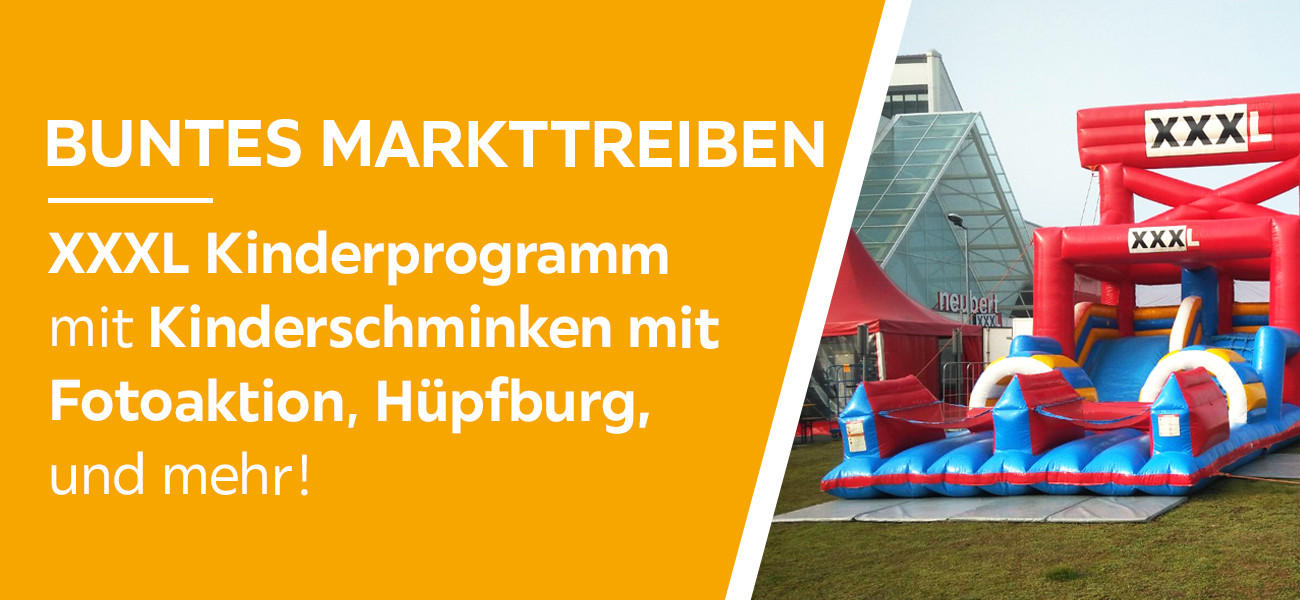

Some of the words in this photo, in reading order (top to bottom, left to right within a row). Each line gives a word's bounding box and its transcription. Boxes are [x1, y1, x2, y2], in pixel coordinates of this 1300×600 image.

[1150, 110, 1272, 148] XXXL
[1131, 228, 1200, 249] XXXL
[938, 289, 998, 313] neubert
